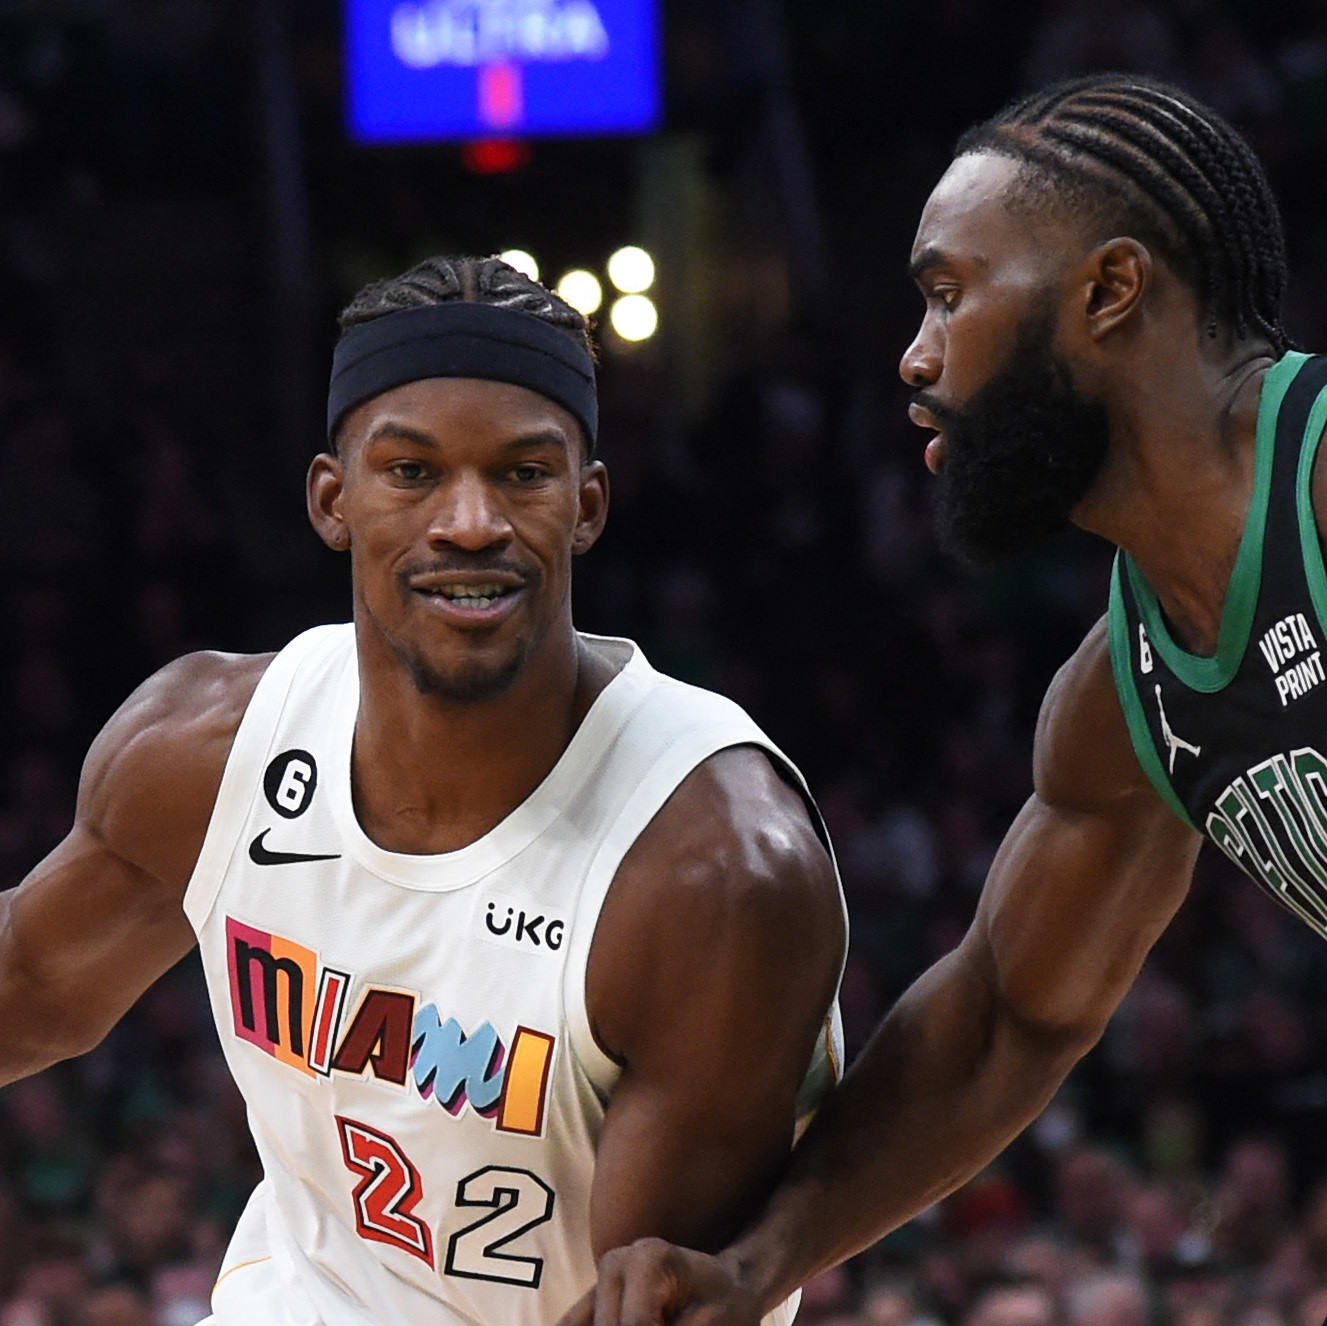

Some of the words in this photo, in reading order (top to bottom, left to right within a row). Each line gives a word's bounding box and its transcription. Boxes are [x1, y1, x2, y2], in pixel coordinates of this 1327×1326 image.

[1258, 612, 1318, 674] VISTA
[1274, 651, 1327, 707] PRINT
[276, 757, 314, 813] 6
[225, 914, 556, 1138] MIAMI
[336, 1115, 556, 1289] 22
